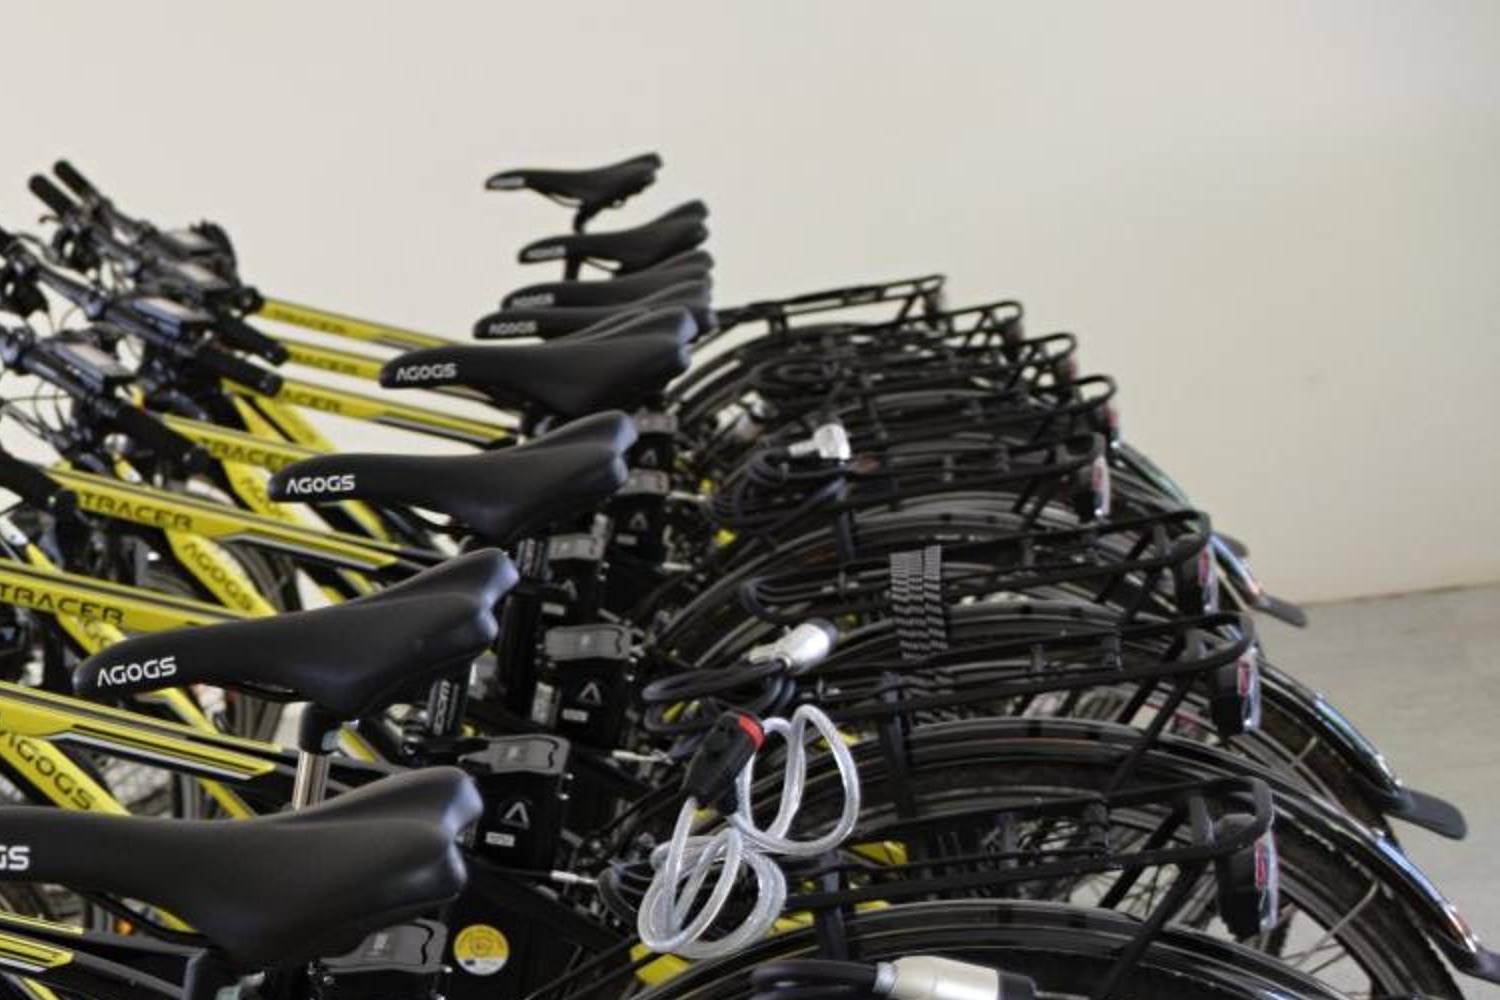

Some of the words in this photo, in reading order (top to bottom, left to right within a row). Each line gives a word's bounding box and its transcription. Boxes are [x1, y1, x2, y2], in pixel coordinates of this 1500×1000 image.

[396, 363, 457, 382] AGOGS
[286, 474, 355, 495] AGOGS
[81, 492, 194, 530] TRACER
[97, 656, 178, 688] AGOGS
